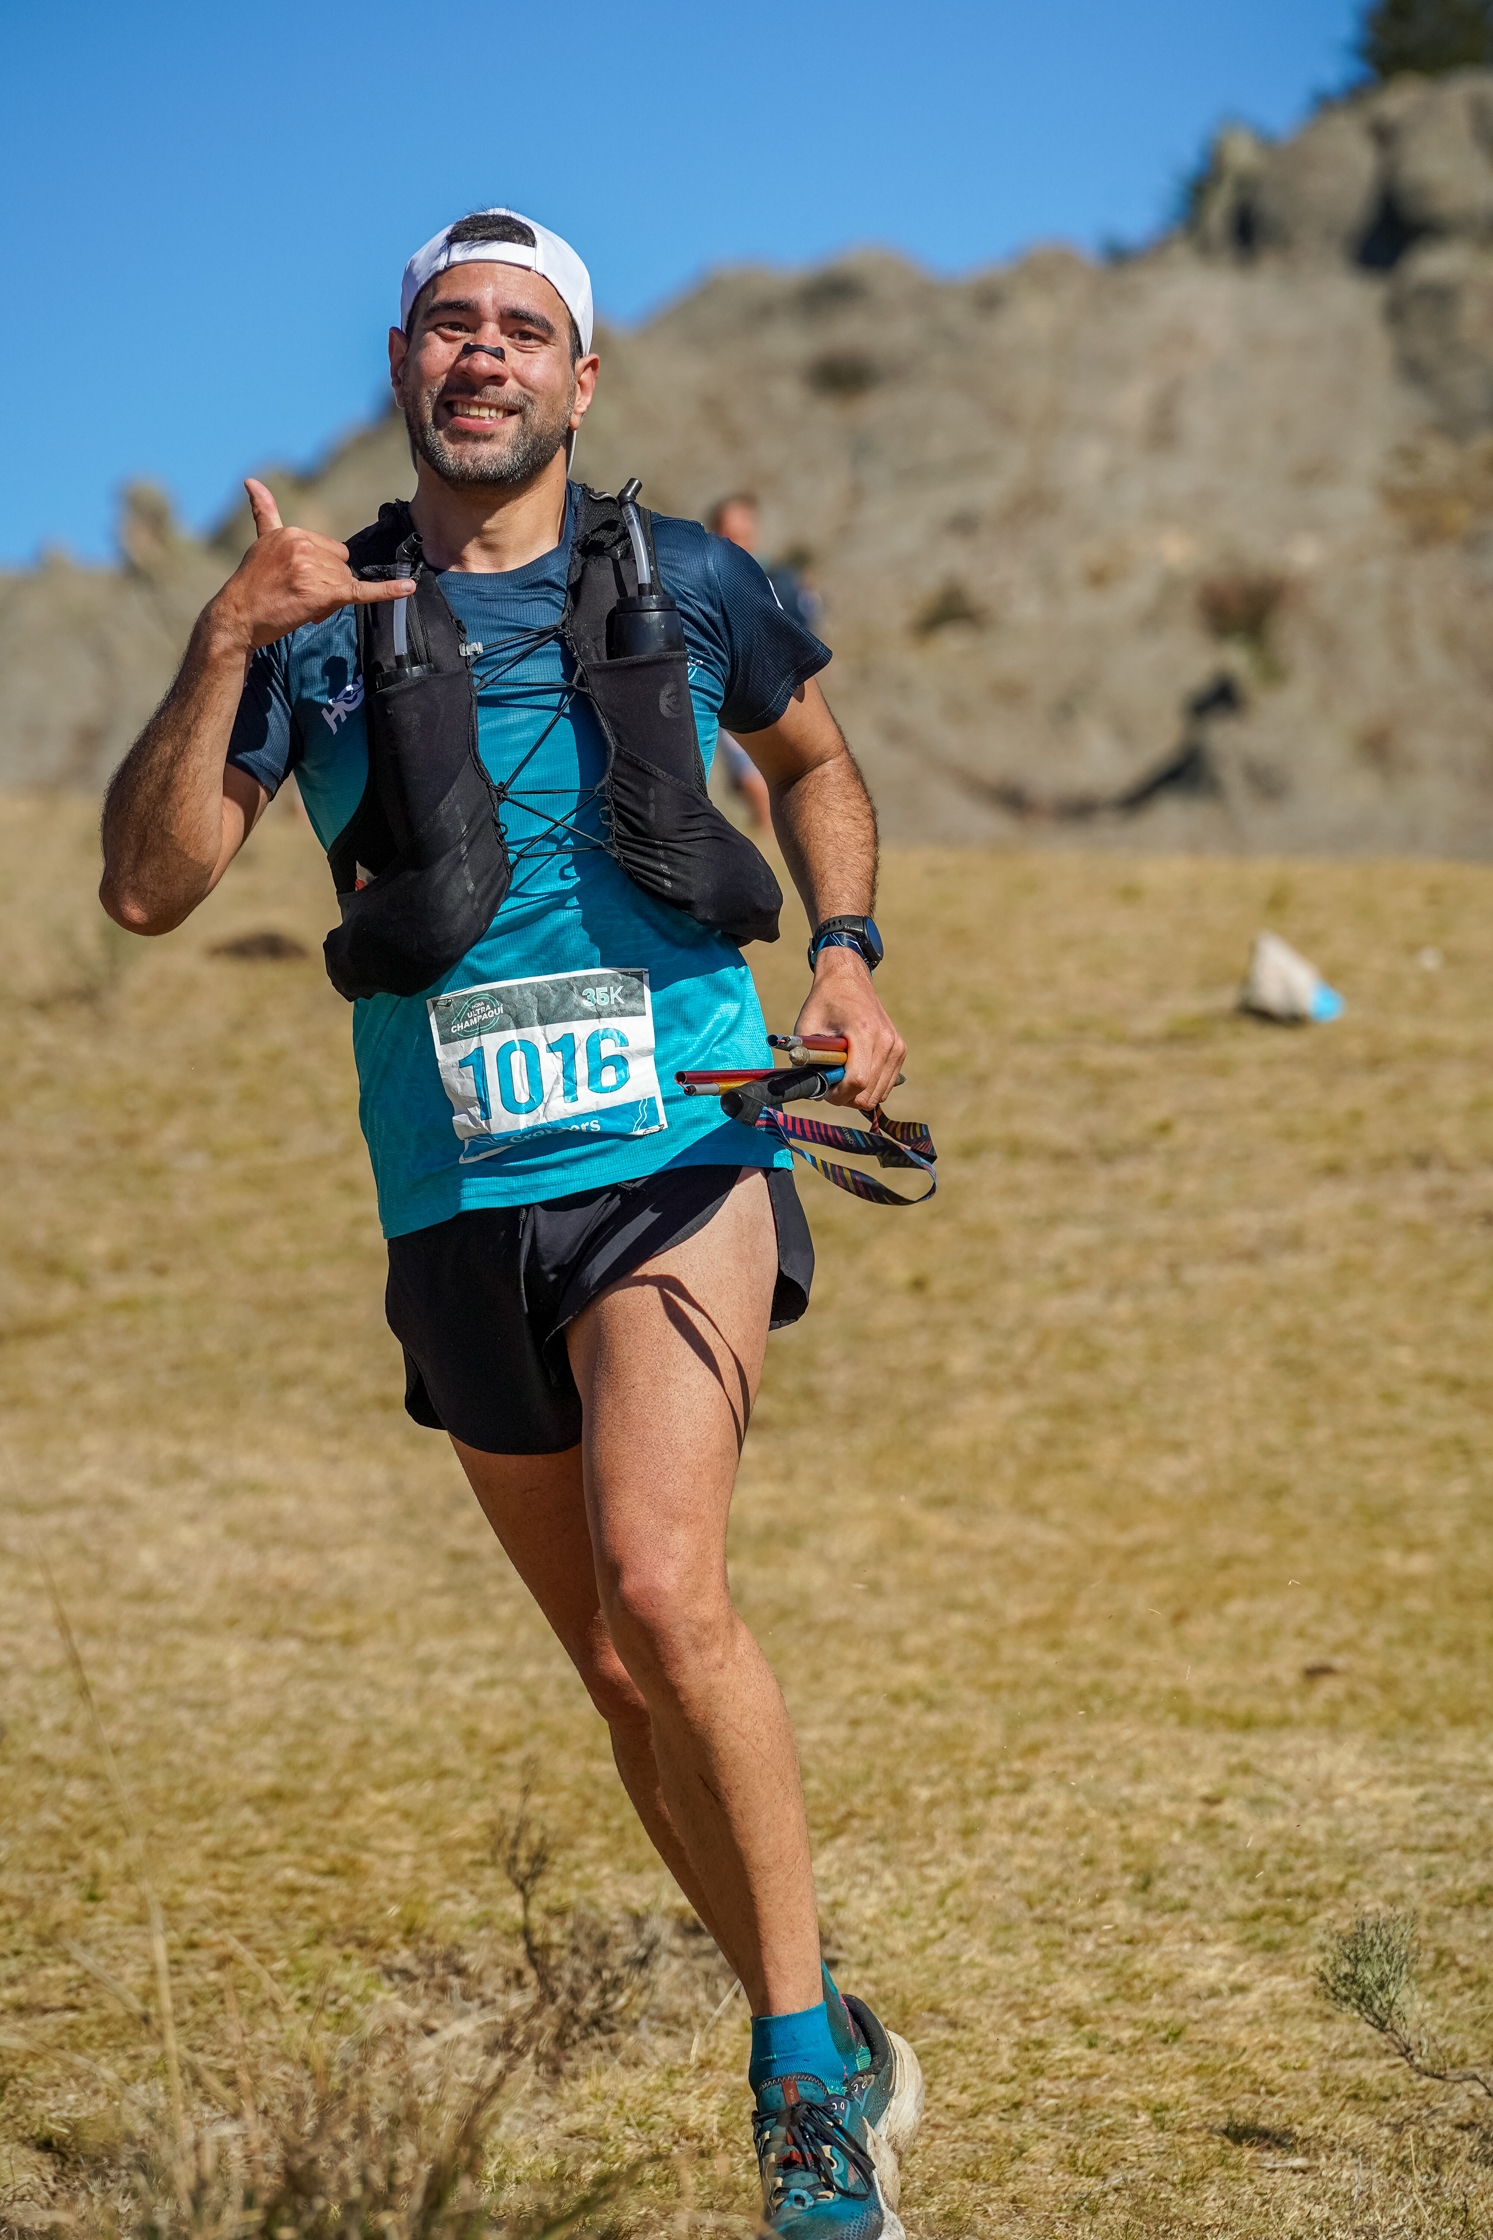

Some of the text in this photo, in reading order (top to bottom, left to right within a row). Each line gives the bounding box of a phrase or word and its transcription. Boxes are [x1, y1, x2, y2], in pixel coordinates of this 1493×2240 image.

[321, 674, 365, 735] HO
[582, 985, 626, 1007] 35K
[450, 1004, 504, 1033] CHAMPAQUÍ
[467, 1004, 491, 1018] ULTRA
[459, 1028, 630, 1121] 1016
